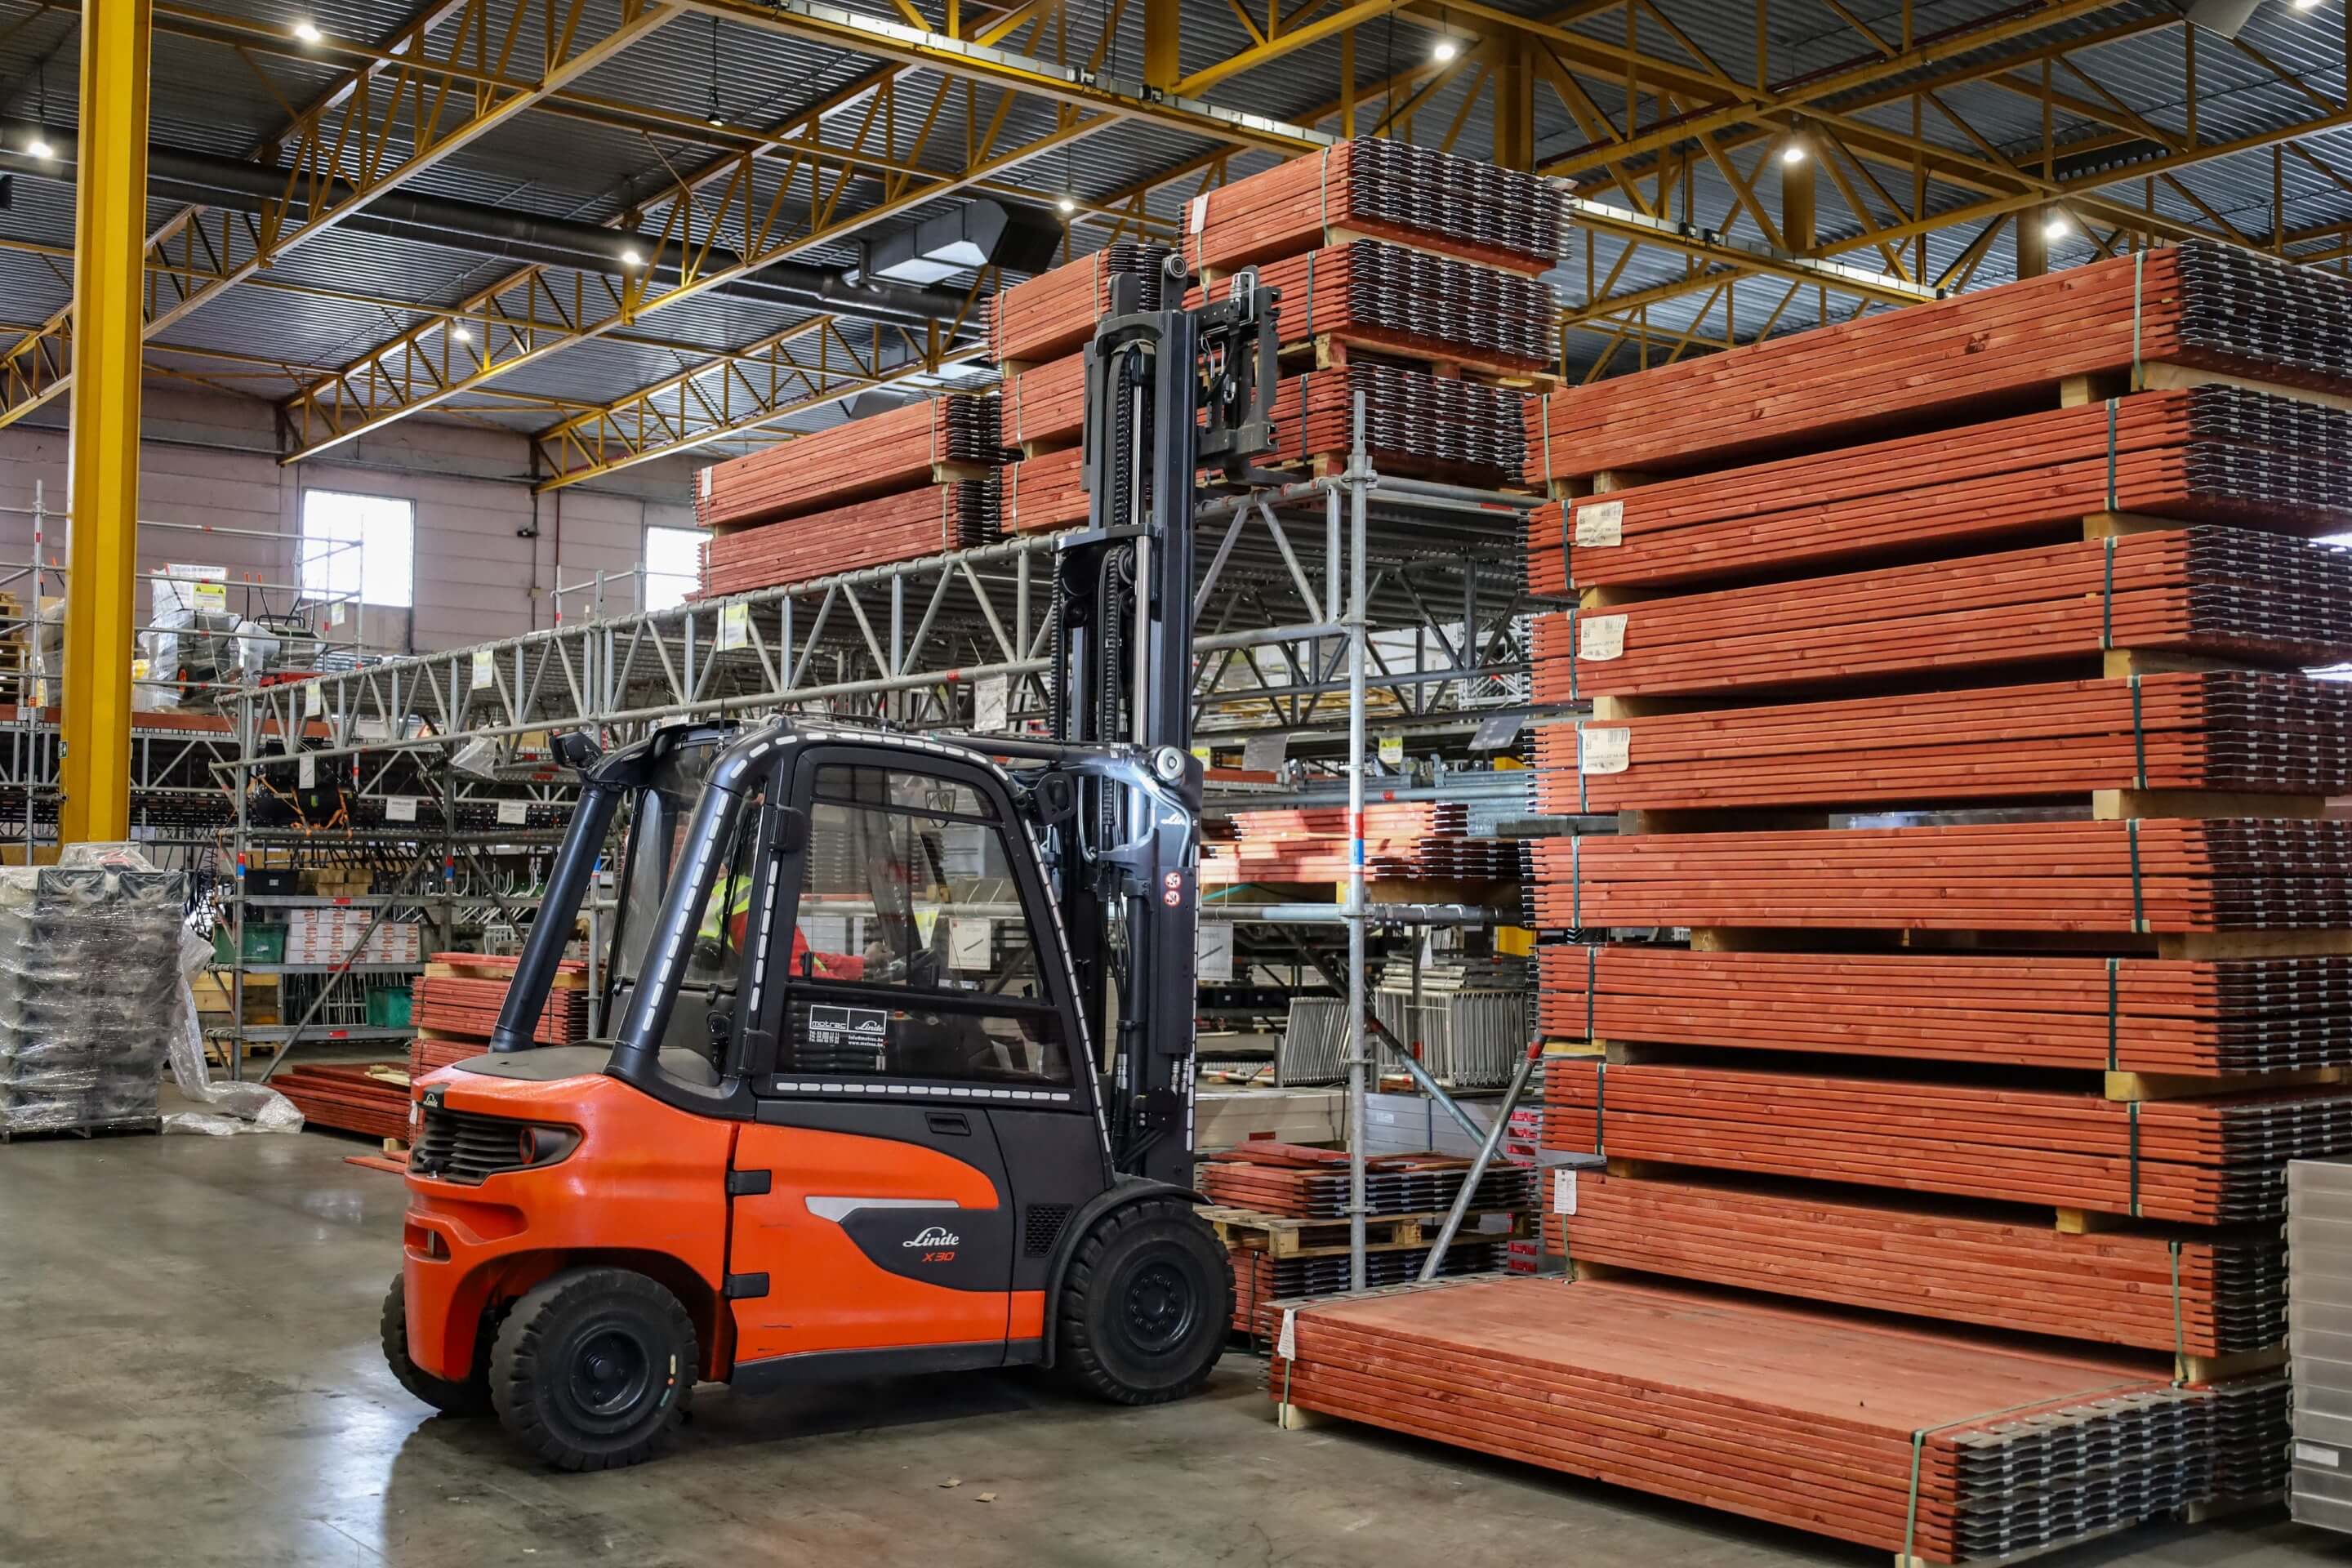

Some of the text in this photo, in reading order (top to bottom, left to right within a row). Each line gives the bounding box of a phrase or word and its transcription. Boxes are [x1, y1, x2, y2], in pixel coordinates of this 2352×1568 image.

[812, 1020, 847, 1030] motrac
[854, 1020, 884, 1032] Linde
[423, 1093, 439, 1107] Linde
[902, 1227, 960, 1247] Linde
